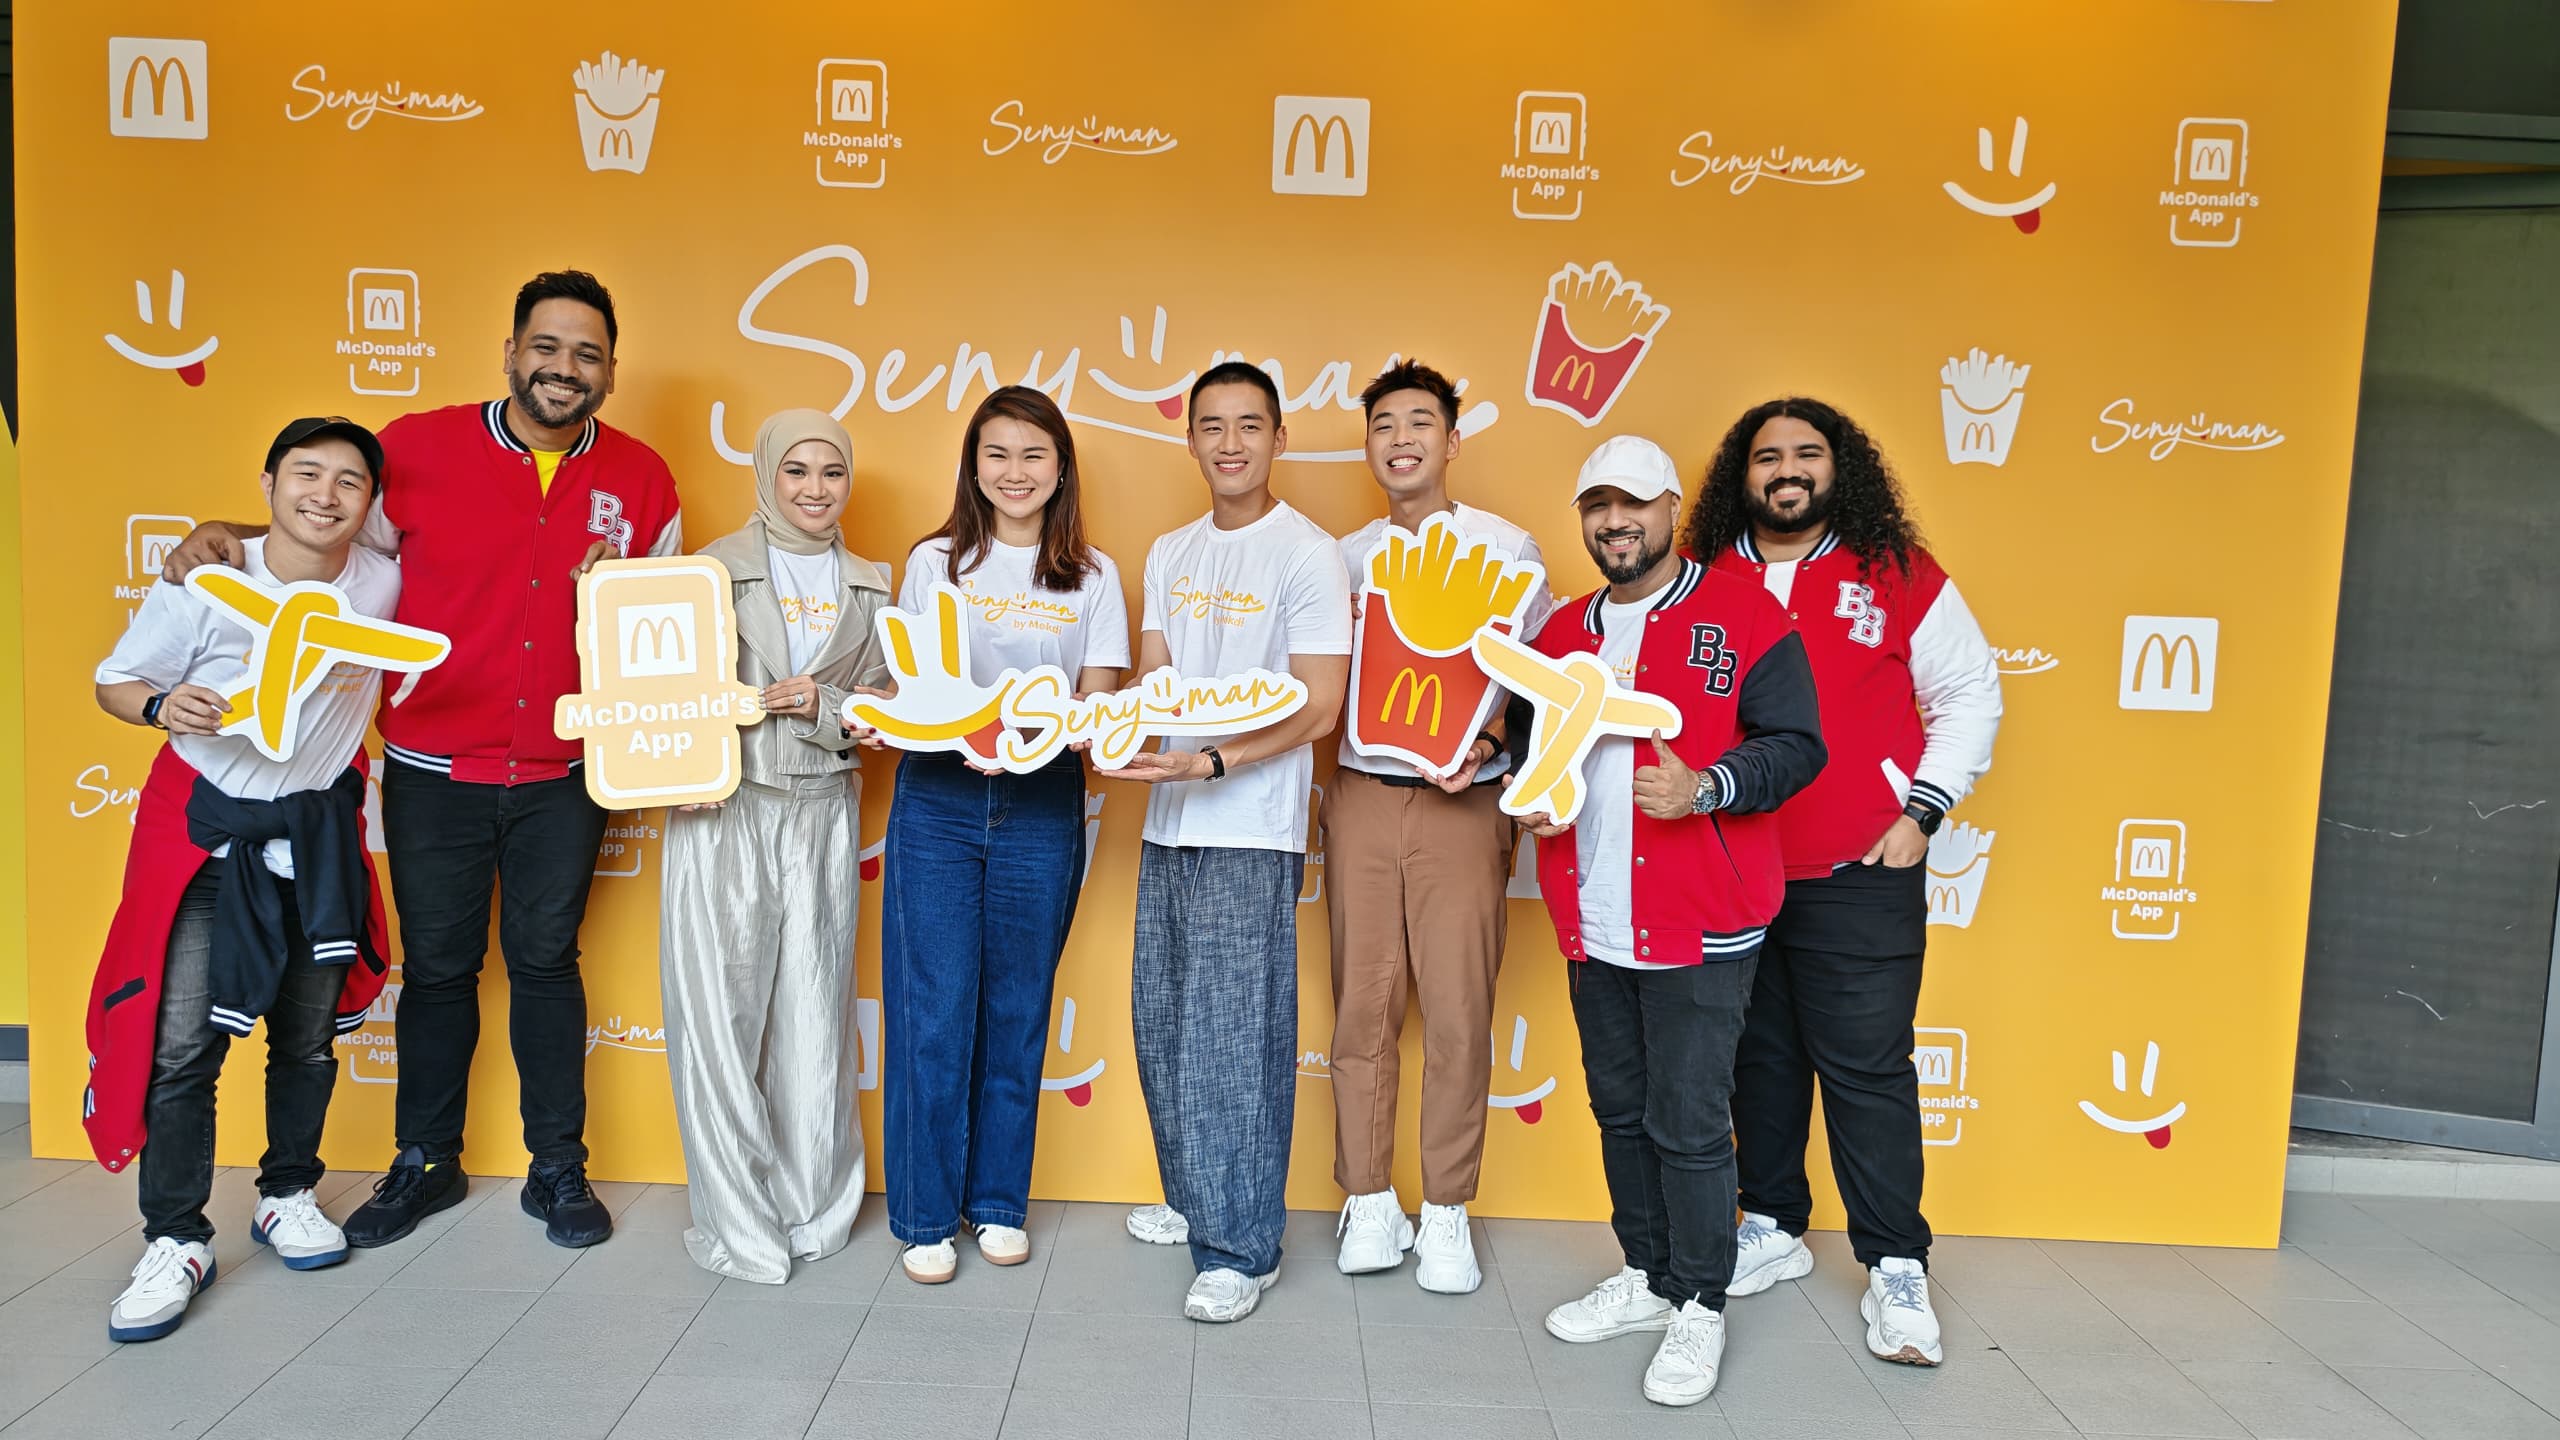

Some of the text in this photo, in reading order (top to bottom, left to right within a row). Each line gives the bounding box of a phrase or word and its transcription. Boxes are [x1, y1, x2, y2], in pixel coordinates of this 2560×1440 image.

[803, 131, 903, 150] McDonald's
[834, 149, 869, 168] App
[1500, 163, 1600, 182] McDonald's
[1531, 181, 1566, 200] App
[2159, 191, 2259, 210] McDonald's
[2188, 208, 2225, 227] App
[335, 339, 437, 358] McDonald's
[367, 357, 403, 376] App
[1687, 622, 1738, 697] BB
[565, 692, 756, 728] McDonald's
[628, 729, 692, 758] App
[604, 825, 658, 839] nald's
[2101, 886, 2197, 905] McDonald's
[2130, 902, 2164, 921] App
[337, 1032, 396, 1046] McDon
[1920, 1095, 1978, 1109] onald's
